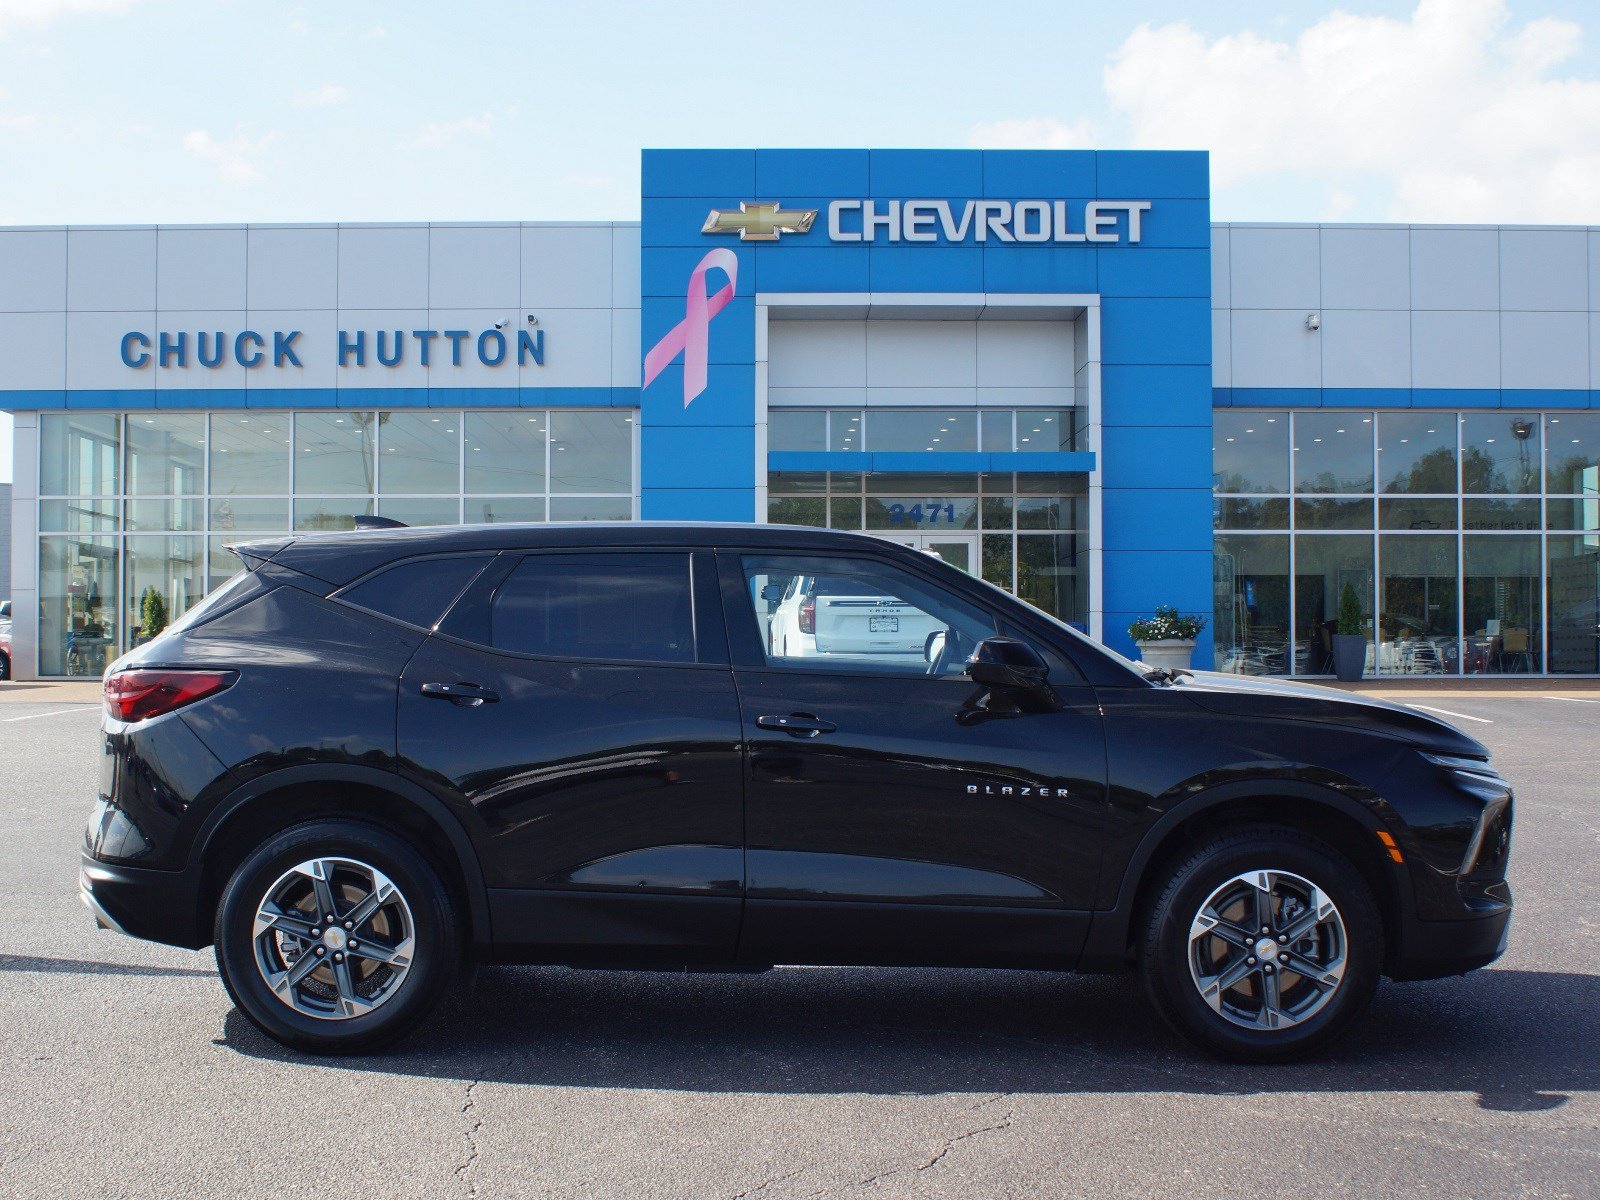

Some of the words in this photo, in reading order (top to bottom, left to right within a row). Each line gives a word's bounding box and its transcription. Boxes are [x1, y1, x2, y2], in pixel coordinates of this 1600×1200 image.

[828, 200, 1151, 242] CHEVROLET
[120, 331, 303, 368] CHUCK
[338, 330, 545, 367] HUTTON
[889, 503, 955, 523] 2471
[1526, 520, 1554, 530] dre
[966, 784, 1068, 798] BLAZER
